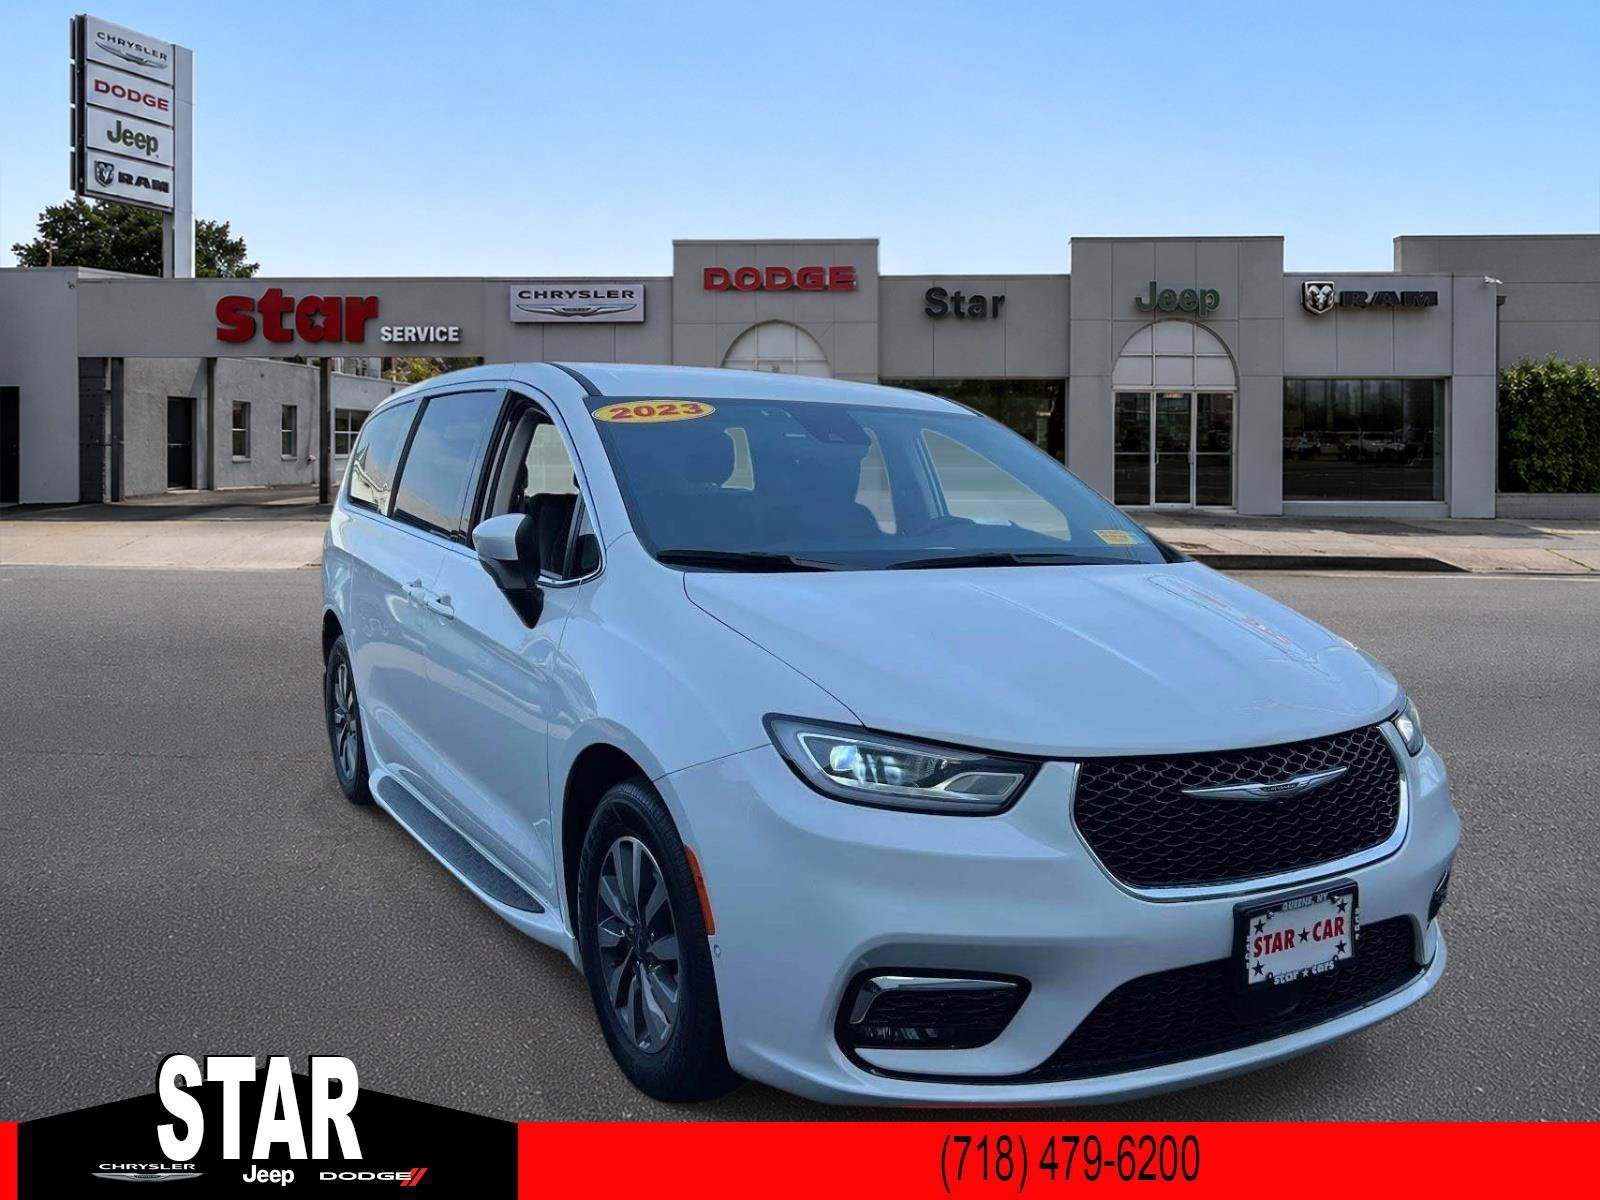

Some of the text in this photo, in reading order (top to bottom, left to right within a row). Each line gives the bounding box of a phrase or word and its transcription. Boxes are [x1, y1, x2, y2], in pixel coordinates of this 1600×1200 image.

[97, 31, 168, 62] CHRYSLER
[94, 79, 169, 112] DODGE
[107, 120, 159, 156] Jeep
[118, 171, 170, 193] RAM
[518, 289, 636, 300] CHRYSLER
[703, 266, 857, 292] DODGE
[924, 285, 1006, 320] Star
[1136, 280, 1220, 317] Jeep
[1338, 289, 1439, 309] RAM
[215, 288, 460, 343] star SERVICE
[609, 403, 703, 420] 2023
[1253, 928, 1296, 958] STAR
[1312, 916, 1345, 943] CAR
